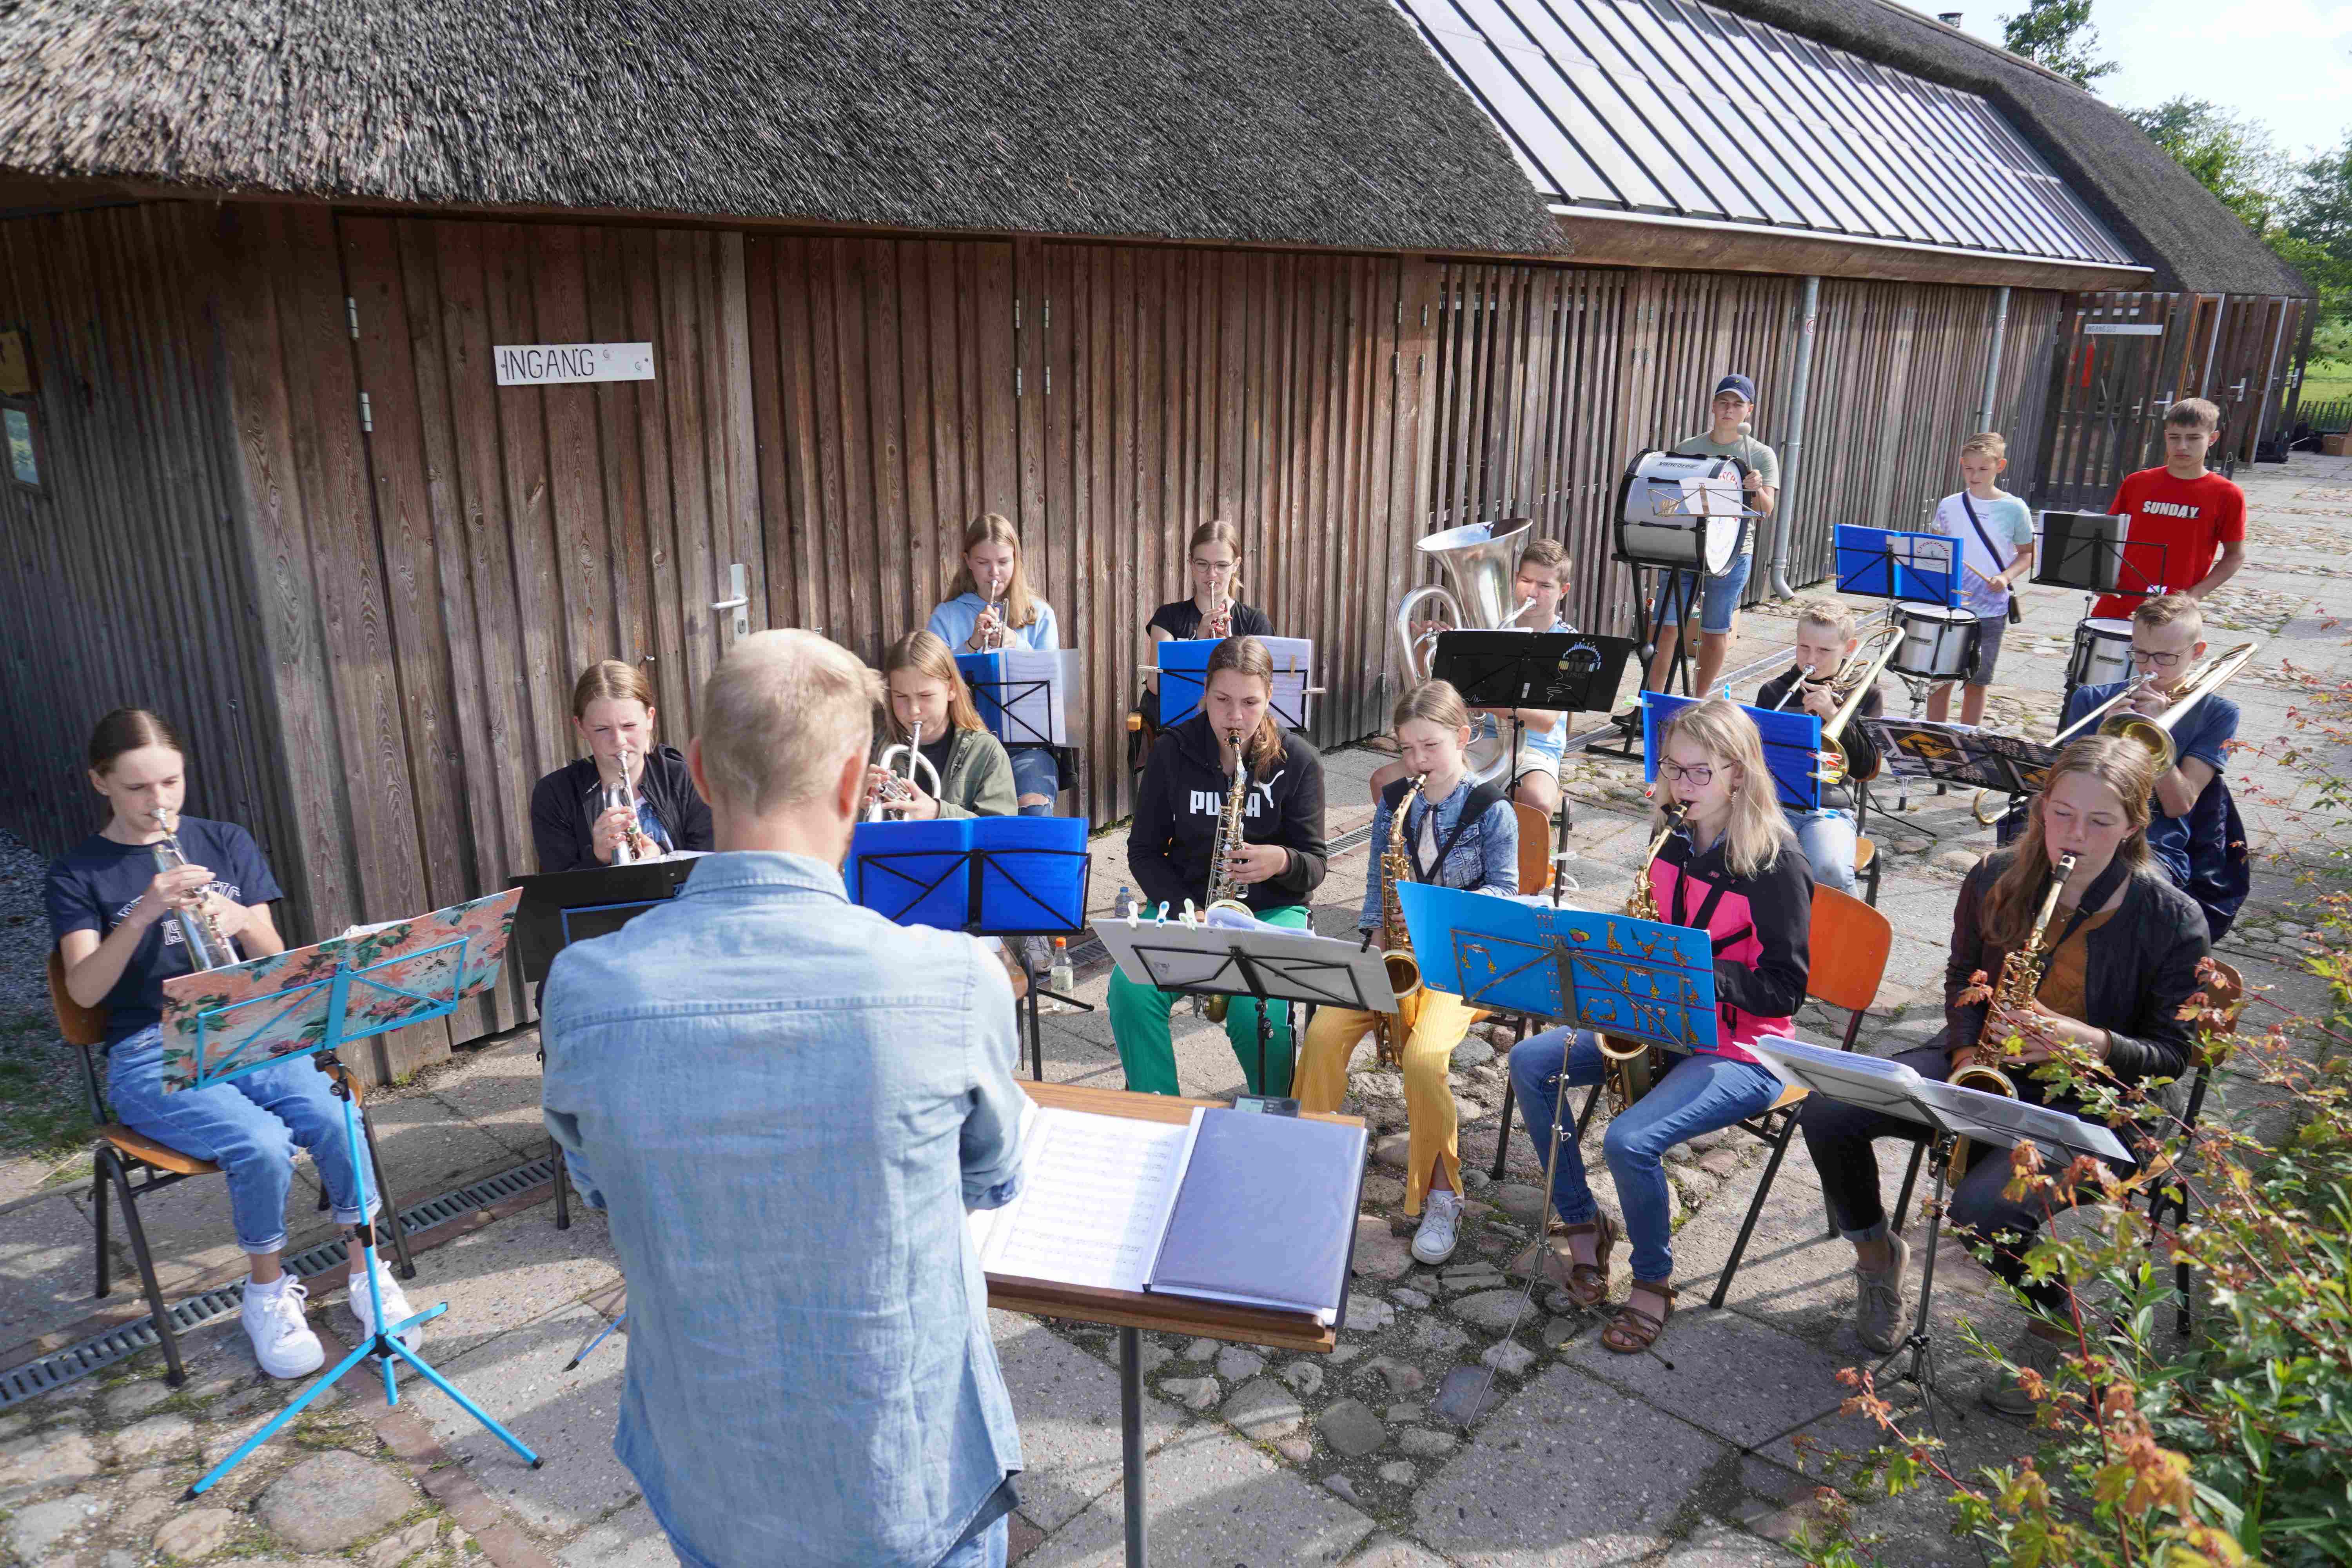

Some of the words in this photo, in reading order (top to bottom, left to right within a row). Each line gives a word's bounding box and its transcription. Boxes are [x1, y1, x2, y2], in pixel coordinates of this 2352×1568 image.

[503, 348, 594, 380] INGANG
[2142, 500, 2201, 519] SUNDAY
[1190, 789, 1261, 818] PUA
